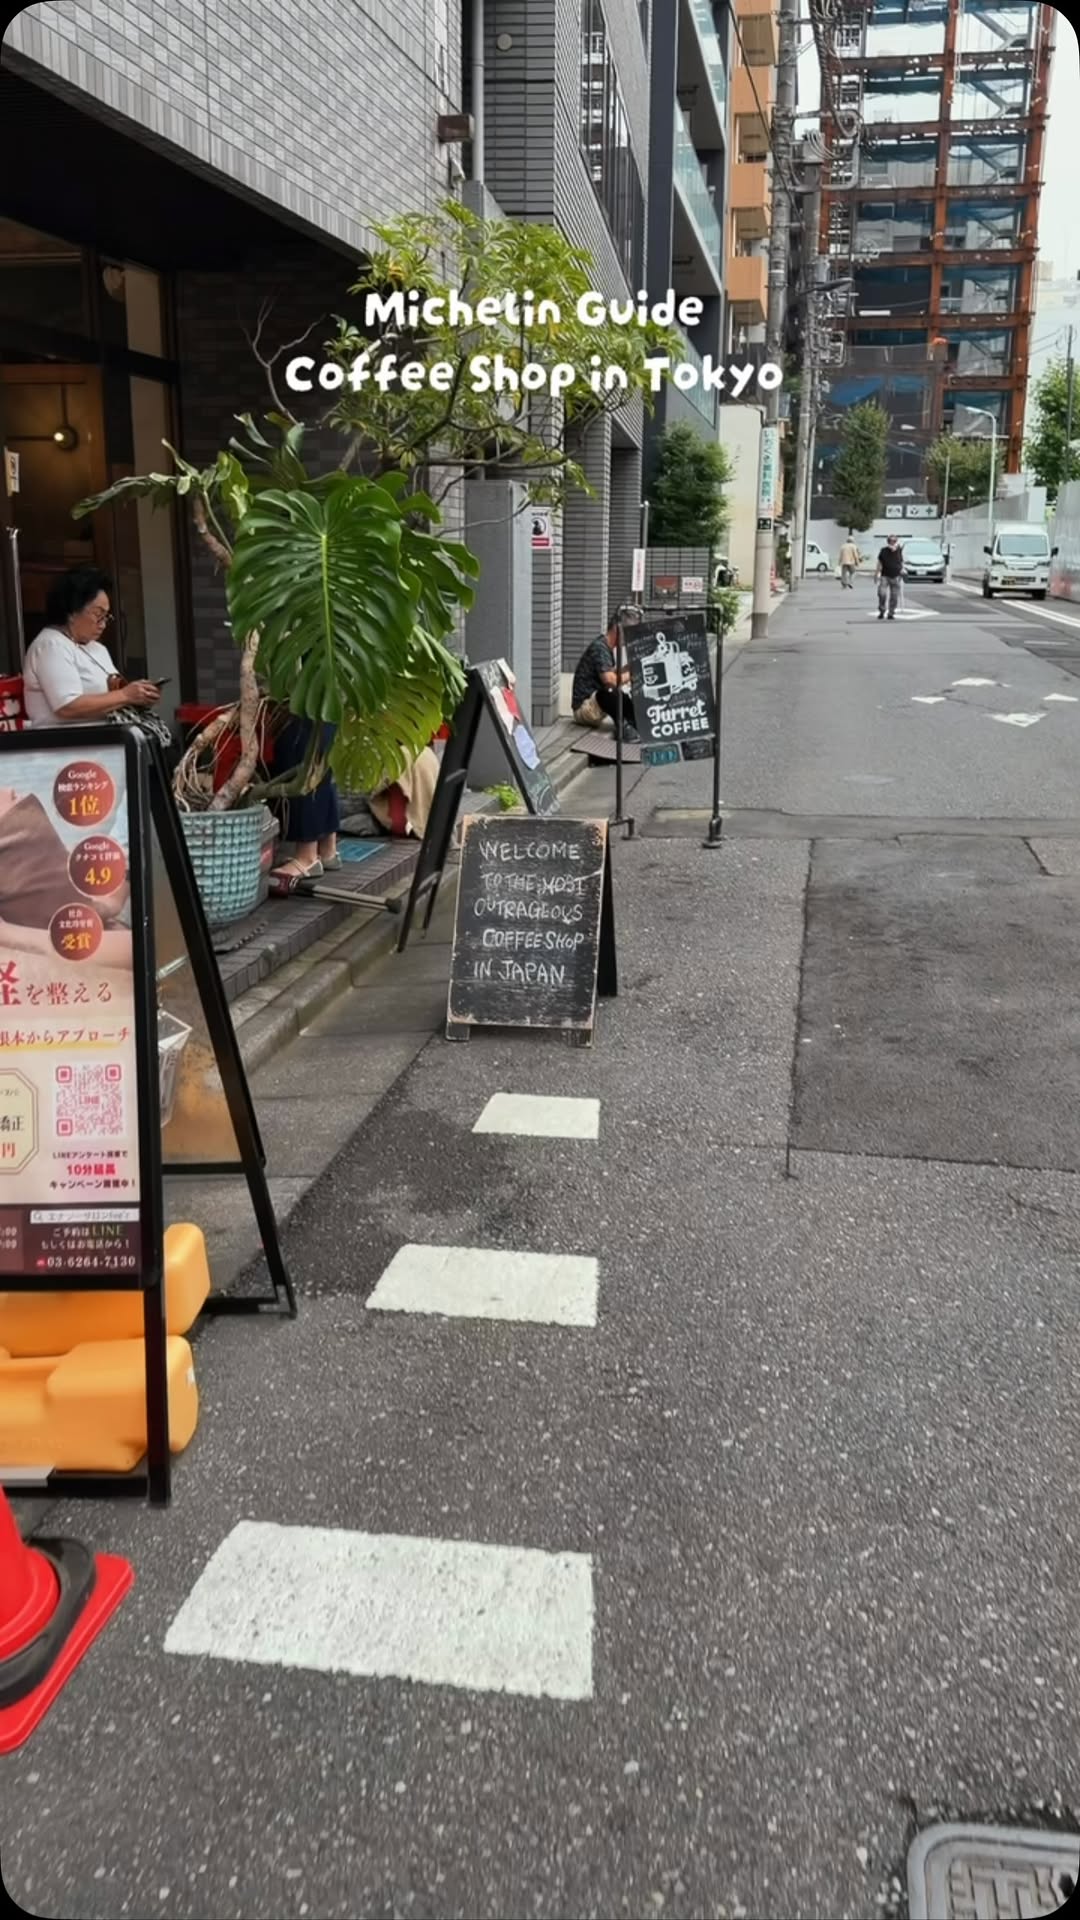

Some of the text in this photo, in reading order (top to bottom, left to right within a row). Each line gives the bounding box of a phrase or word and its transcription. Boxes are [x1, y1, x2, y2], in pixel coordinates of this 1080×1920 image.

[646, 699, 707, 725] Turret
[651, 717, 709, 738] COFFEE
[68, 770, 97, 780] Google
[70, 795, 100, 816] 1位
[84, 842, 111, 851] Google
[479, 841, 581, 862] WELCOME
[85, 867, 112, 885] 4.9
[481, 871, 585, 897] TO THE MOST
[474, 896, 583, 925] OUTRAGEOUS
[61, 932, 92, 950] 受賞
[474, 957, 565, 984] IN JAPAN
